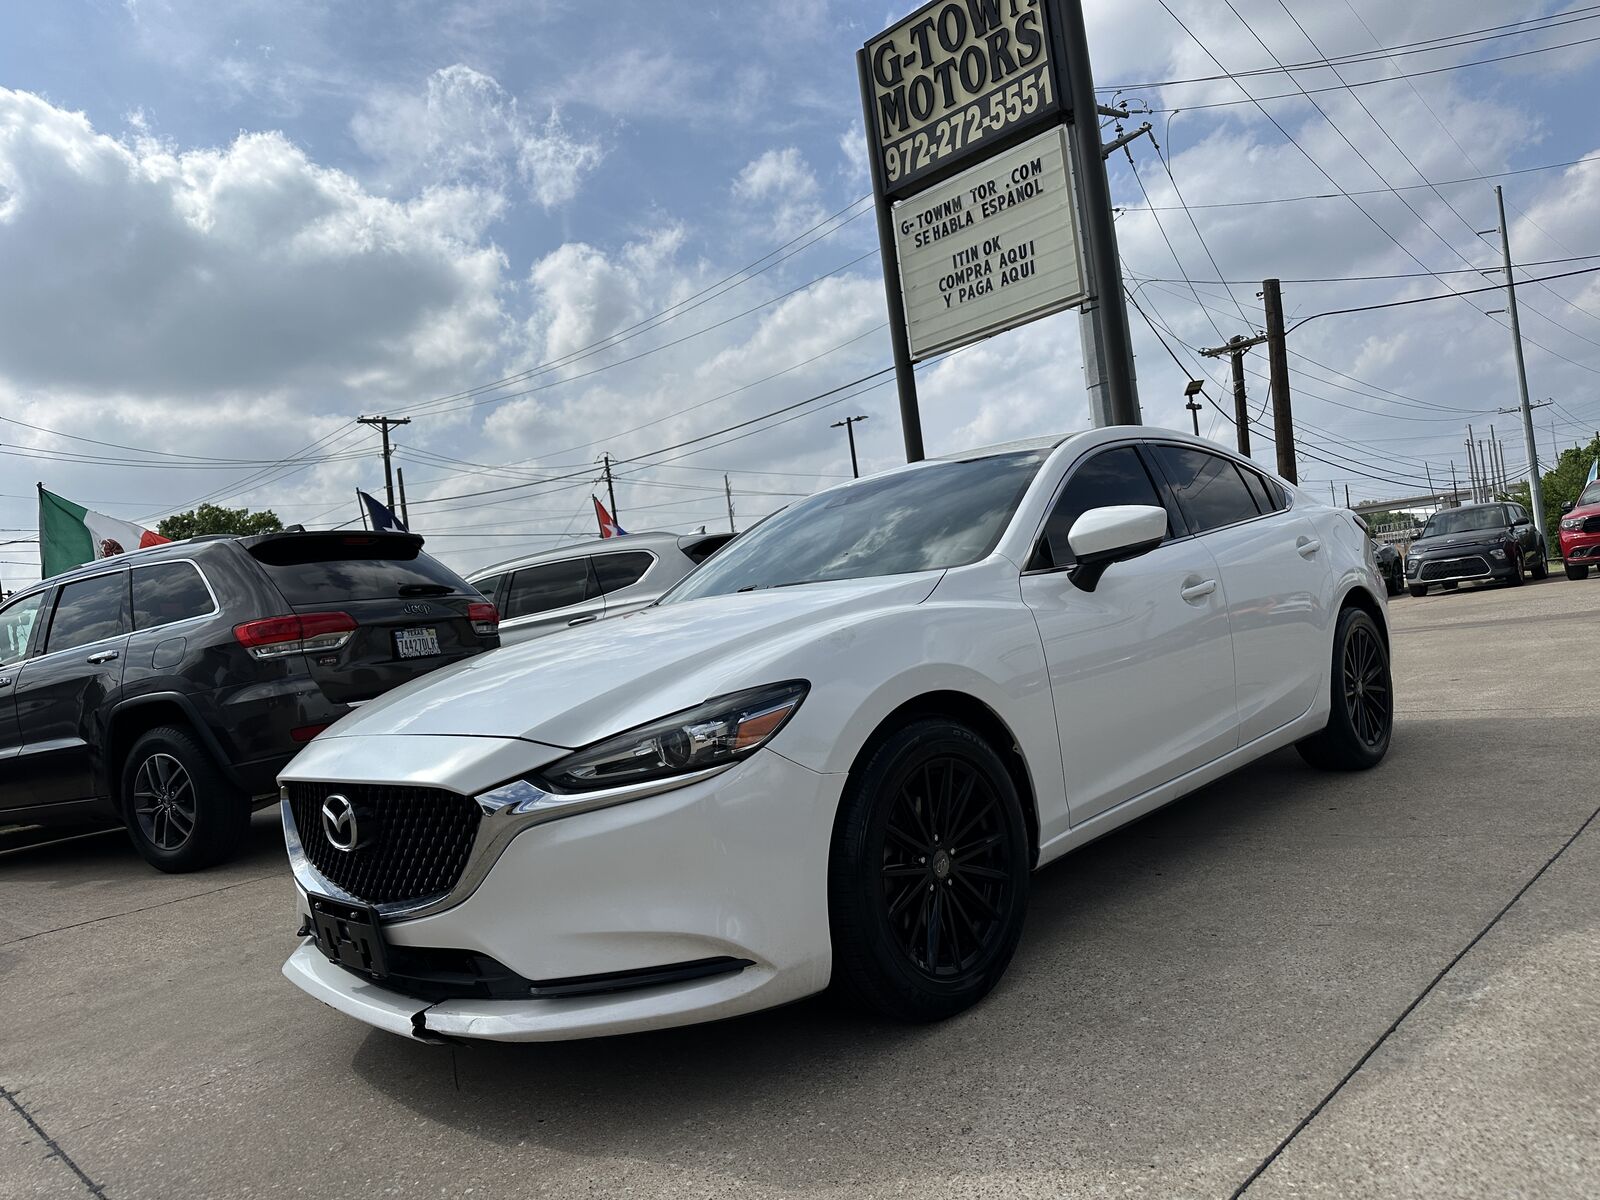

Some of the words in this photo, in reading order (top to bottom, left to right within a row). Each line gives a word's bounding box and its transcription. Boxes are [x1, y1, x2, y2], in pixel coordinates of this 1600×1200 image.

[878, 10, 1042, 139] MOTORS
[885, 65, 1053, 182] 972-272-5551
[934, 210, 974, 241] HABLA
[982, 179, 1044, 218] ESPANOL
[970, 180, 997, 202] TOR
[939, 259, 992, 292] COMPRA
[999, 240, 1035, 269] AQUI
[952, 249, 979, 269] ITIN
[983, 236, 1002, 256] OK
[943, 292, 952, 309] Y
[959, 280, 994, 303] PAGA
[1001, 260, 1036, 287] AQUI
[403, 603, 431, 615] Jeep
